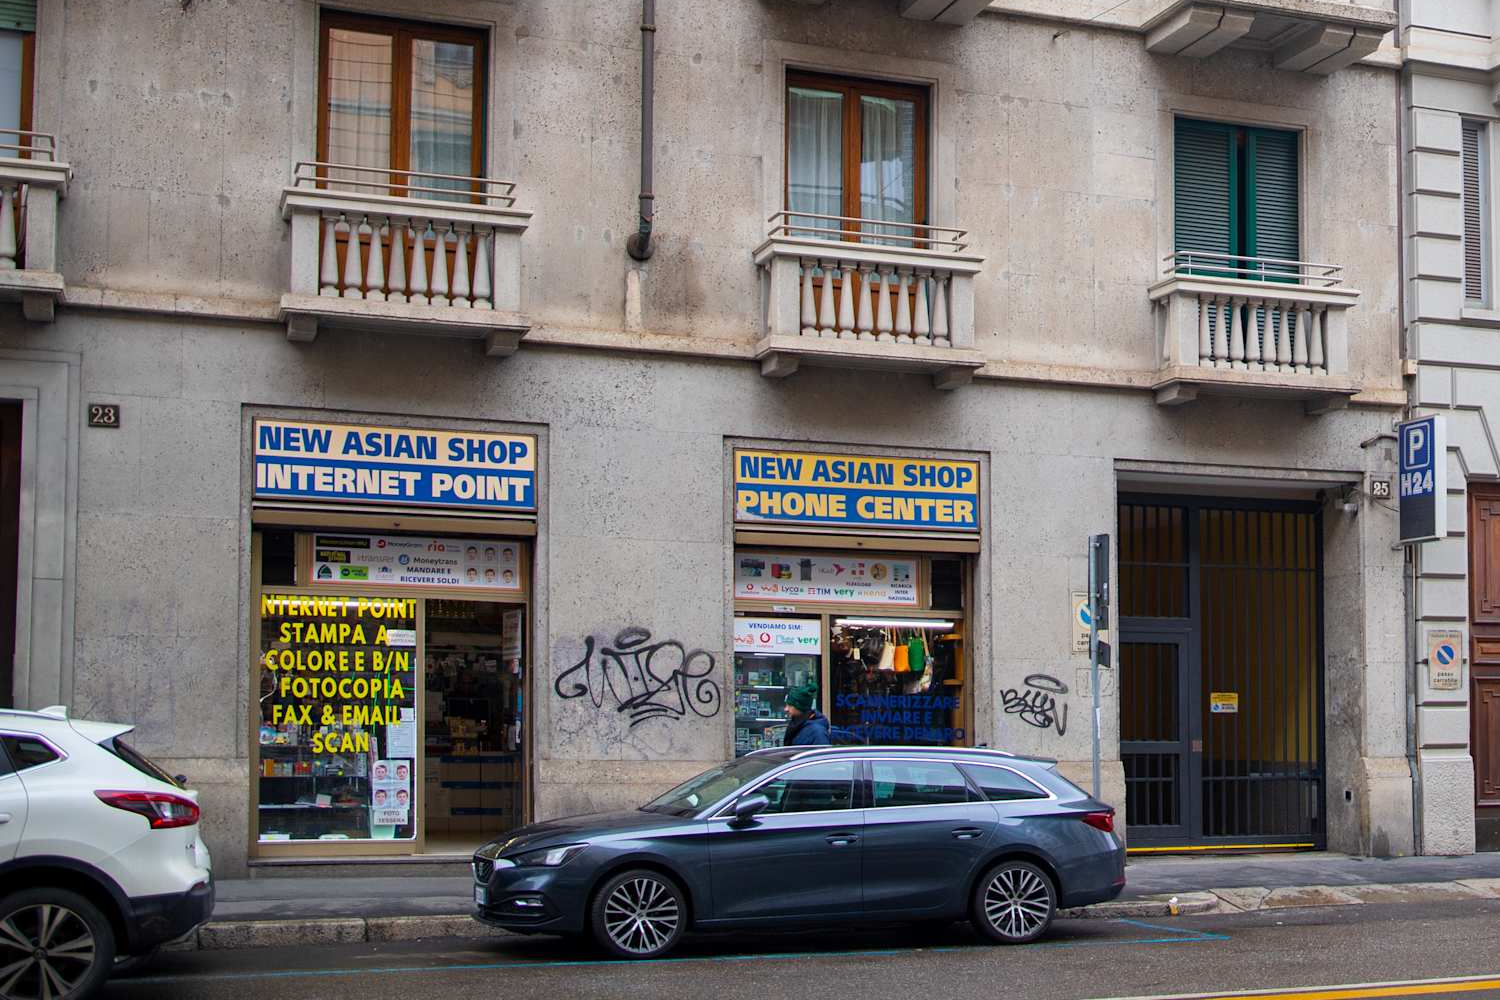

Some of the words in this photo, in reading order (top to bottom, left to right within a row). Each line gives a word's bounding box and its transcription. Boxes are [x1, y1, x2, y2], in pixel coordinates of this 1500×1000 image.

[92, 406, 115, 424] 23
[259, 425, 332, 453] NEW
[342, 431, 437, 460] ASIAN
[448, 437, 528, 465] SHOP
[1409, 428, 1425, 465] P
[257, 462, 421, 497] INTERNET
[431, 472, 531, 502] POINT
[740, 455, 803, 481] NEW
[812, 459, 894, 485] ASIAN
[903, 464, 972, 489] SHOP
[1373, 482, 1389, 496] 25
[1401, 469, 1434, 497] H24
[737, 489, 847, 518] PHONE
[856, 495, 974, 523] CENTER
[427, 540, 445, 552] ria
[406, 566, 441, 574] MANDARE
[413, 556, 458, 566] Moneytrans
[400, 576, 435, 584] RICEVERE
[437, 577, 460, 585] SOLDI
[816, 587, 831, 596] TIM
[834, 588, 854, 597] very
[357, 597, 416, 619] POINT
[279, 622, 367, 644] STAMPA
[375, 624, 389, 646] A
[749, 622, 787, 631] VENDIAMO
[798, 636, 819, 646] very
[265, 649, 349, 672] COLORE
[354, 650, 365, 672] E
[372, 650, 409, 675] B/N
[280, 676, 405, 699] FOTOCOPIA
[835, 693, 961, 709] SCANNERIZZARE
[272, 704, 313, 726] FAX
[320, 704, 336, 726] &
[342, 704, 401, 727] EMAIL
[860, 710, 921, 725] INVIARE
[924, 711, 933, 725] E
[312, 731, 369, 754] SCAN
